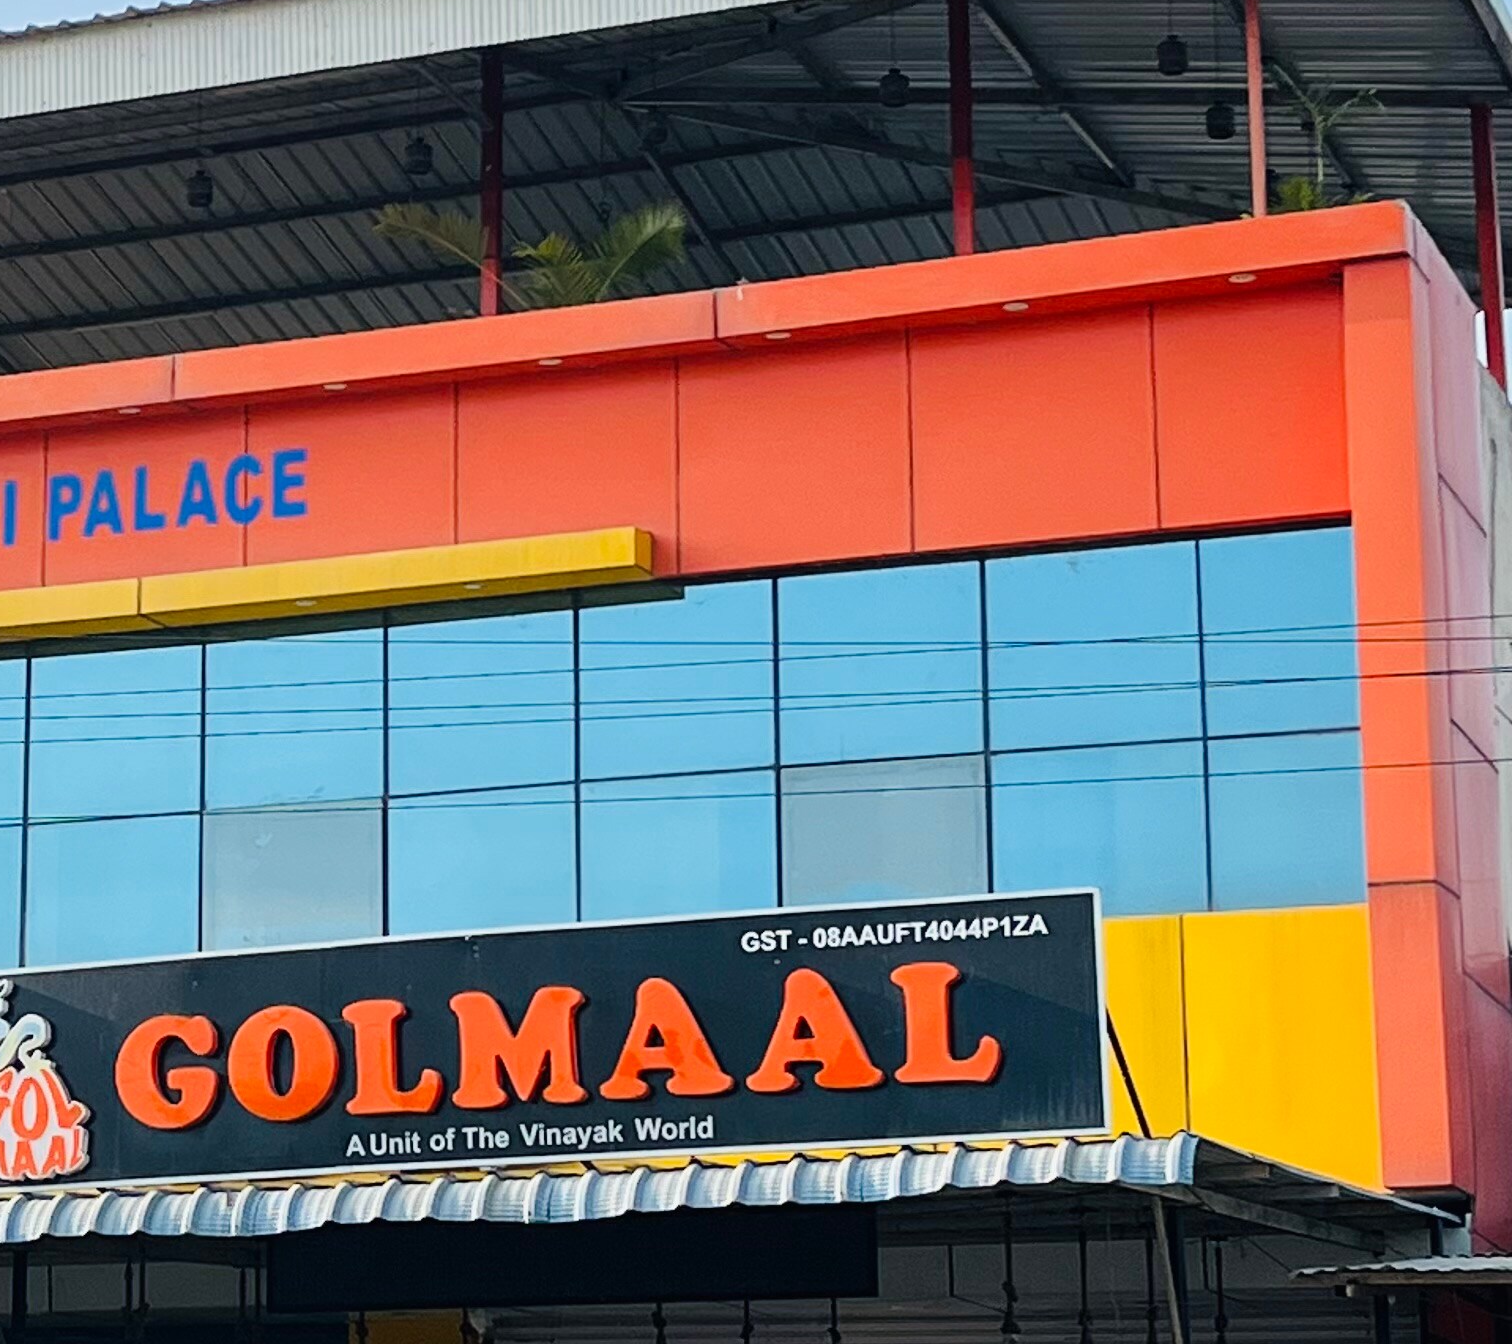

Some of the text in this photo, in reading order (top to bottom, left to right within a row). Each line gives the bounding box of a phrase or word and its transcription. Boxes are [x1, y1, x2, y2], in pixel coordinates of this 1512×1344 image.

[47, 448, 309, 542] PALACE
[740, 929, 793, 953] GST
[812, 914, 1050, 949] 08AAUFT4044P1ZA
[114, 961, 1002, 1130] GOLMAAL
[369, 1131, 422, 1156] Unit
[429, 1127, 458, 1152] of
[462, 1126, 510, 1150] The
[519, 1120, 624, 1150] Vinayak
[634, 1115, 714, 1142] World
